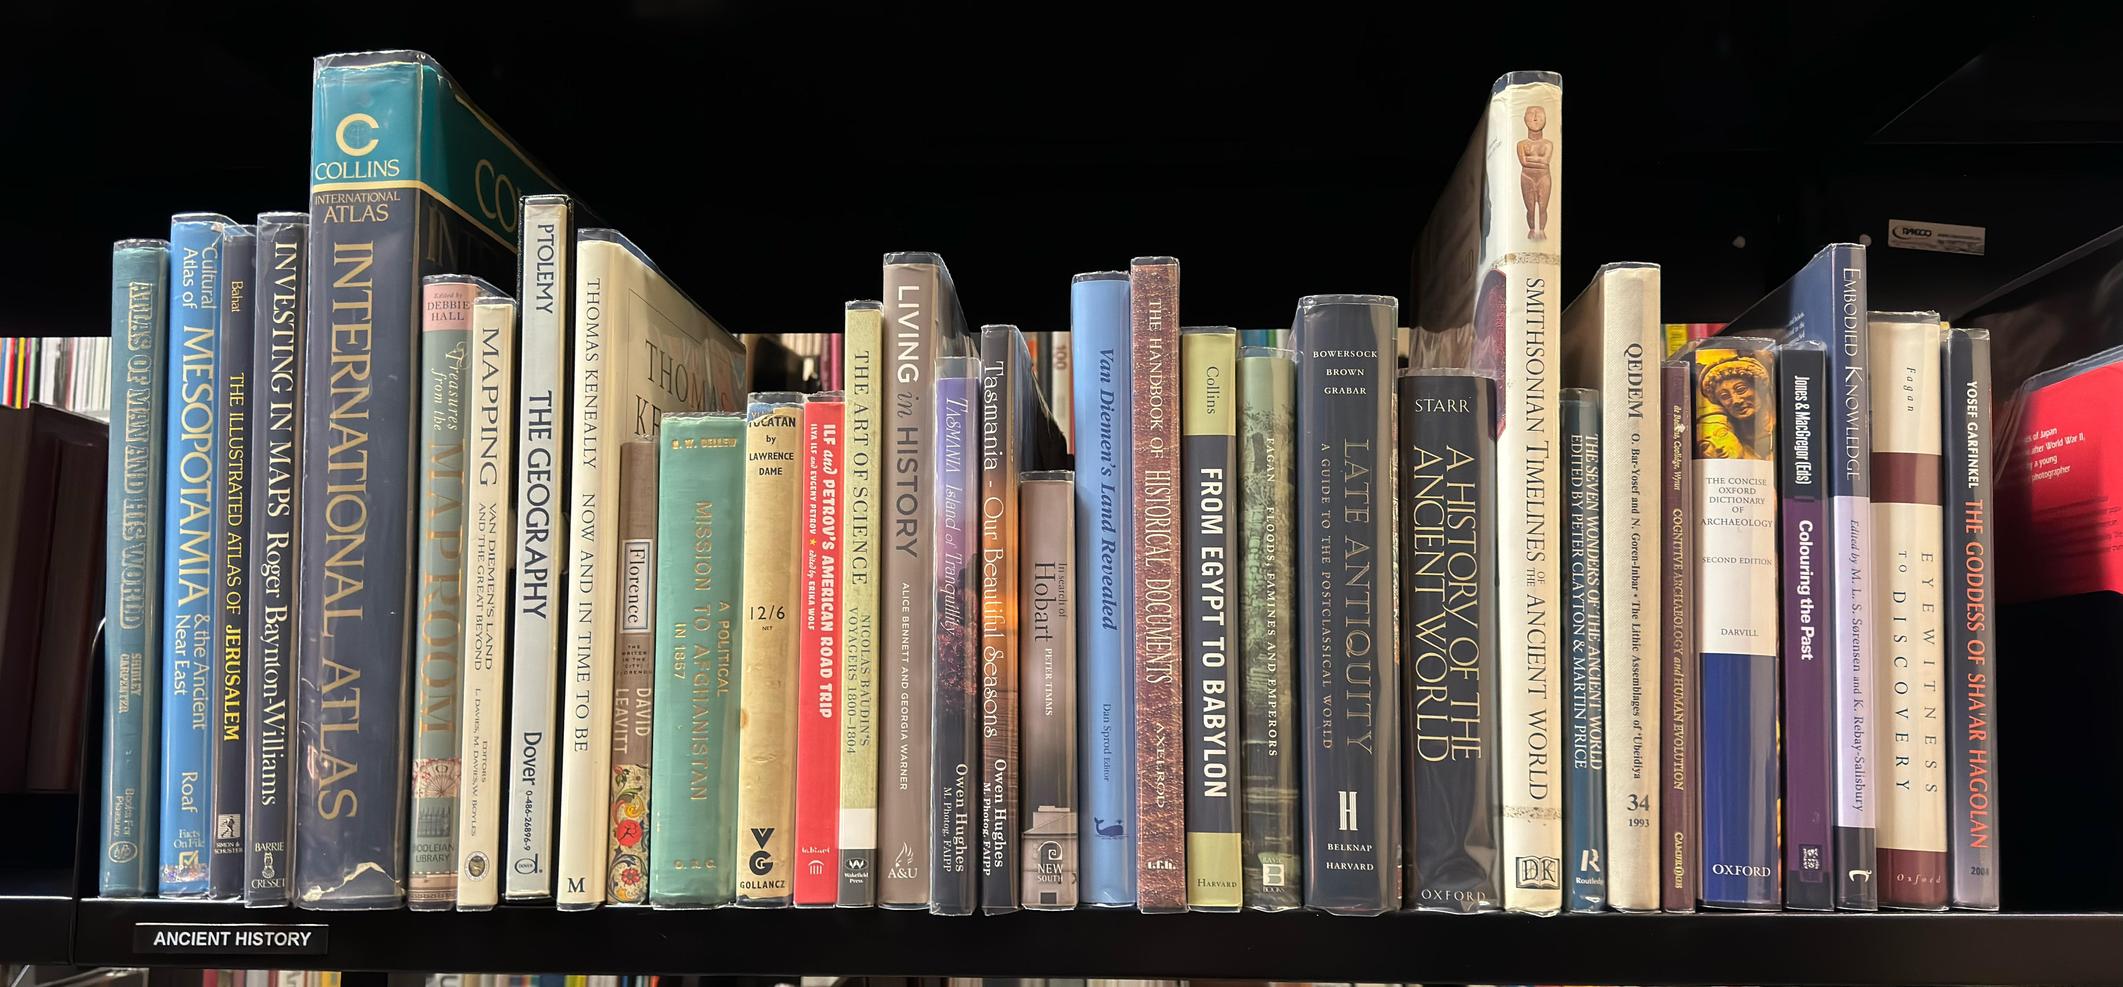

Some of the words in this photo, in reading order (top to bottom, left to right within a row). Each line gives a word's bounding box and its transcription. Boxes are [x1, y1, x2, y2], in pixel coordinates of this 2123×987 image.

[315, 160, 400, 180] COLLINS
[315, 192, 400, 205] INTERNATIONAL
[324, 204, 389, 224] ATLAS
[536, 223, 554, 314] PTOLEMY
[127, 282, 152, 350] ATLAS
[231, 281, 243, 312] Bahat
[427, 300, 471, 310] DEBBIE
[431, 312, 464, 321] HALL
[1149, 300, 1162, 331] THE
[1843, 267, 1862, 357] EMBODIED
[585, 278, 601, 362] THOMAS
[898, 285, 920, 383] LIVING
[127, 355, 152, 382] OF
[854, 350, 869, 395] THE
[1313, 350, 1378, 358] BOWERSOCK
[229, 372, 244, 406] THE
[1148, 338, 1163, 430] HANDBOOK
[1206, 367, 1220, 414] Collins
[1324, 387, 1367, 395] GRABAR
[1624, 343, 1644, 418] QEDEM
[1903, 368, 1916, 412] Fagan
[1967, 381, 1978, 418] YOSEF
[126, 389, 151, 441] MAN
[480, 328, 499, 487] MAPPING
[528, 390, 552, 441] THE
[583, 369, 598, 469] KENEALLY
[854, 403, 869, 446] ART
[897, 392, 919, 418] in
[1415, 399, 1470, 413] STARR
[1845, 365, 1864, 481] KNOWLEDGE
[321, 240, 374, 637] INTERNATIONAL
[823, 424, 836, 446] ILF
[946, 398, 968, 473] TASMANIA
[1150, 437, 1163, 458] OF
[1585, 434, 1599, 462] THE
[1967, 422, 1979, 488] GARFINKEL
[2040, 427, 2058, 440] Japan
[125, 446, 150, 493] AND
[178, 325, 214, 606] MESOPOTAMIA
[228, 412, 244, 525] ILLUSTRATED
[750, 452, 794, 460] LAWRENCE
[760, 468, 782, 476] DAME
[823, 450, 837, 474] and
[854, 452, 869, 481] OF
[1266, 438, 1275, 483] FAGAN
[1446, 445, 1475, 471] A
[428, 439, 464, 561] MAP
[896, 427, 918, 557] HISTORY
[1201, 468, 1223, 535] FROM
[1343, 439, 1370, 523] LATE
[1586, 466, 1600, 510] SEVEN
[1709, 496, 1765, 504] DICTIONARY
[1726, 478, 1768, 486] CONCISE
[122, 497, 146, 540] HIS
[478, 503, 486, 531] AND
[582, 493, 596, 542] NOW
[822, 479, 835, 550] PETROV'S
[945, 484, 963, 530] Island
[1145, 470, 1172, 567] HISTORICAL
[1413, 445, 1445, 603] ANCIENT
[1965, 500, 1984, 534] THE
[523, 448, 551, 619] GEOGRAPHY
[694, 501, 713, 591] MISSION
[851, 487, 869, 585] SCIENCE
[945, 534, 956, 548] of
[1265, 507, 1275, 567] FLOODS,
[1443, 482, 1478, 629] HISTORY
[1586, 516, 1600, 585] WONDERS
[1851, 520, 1860, 551] Edited
[227, 532, 242, 586] ATLAS
[580, 550, 594, 593] AND
[1797, 520, 1814, 594] Colouring
[1849, 552, 1860, 564] by
[1851, 568, 1861, 585] M.
[1898, 551, 1908, 573] TO
[120, 544, 146, 629] WORLD
[226, 592, 241, 615] OF
[476, 565, 485, 609] GREAT
[628, 548, 646, 624] Florence
[821, 555, 834, 632] AMERICAN
[940, 553, 962, 636] Tranquillity
[1034, 562, 1056, 642] Hobart
[1201, 546, 1224, 626] EGYPT
[1266, 572, 1276, 636] FAMINES
[1587, 589, 1600, 609] OF
[1852, 588, 1861, 600] L.
[1966, 541, 1985, 632] GODDESS
[579, 601, 593, 624] IN
[674, 623, 686, 638] IN
[694, 604, 711, 632] TO
[750, 606, 785, 620] 12/6
[1588, 612, 1601, 641] THE
[1799, 598, 1814, 622] the
[1852, 603, 1862, 615] S.
[419, 568, 462, 737] ROOM
[474, 615, 484, 671] BEYOND
[1146, 579, 1173, 684] DOCUMENTS
[1202, 637, 1225, 667] TO
[1344, 536, 1372, 755] ANTIQUITY
[1800, 626, 1814, 660] Past
[1852, 618, 1863, 674] Sørensen
[1967, 638, 1985, 666] OF
[131, 653, 141, 696] SHIRLEY
[577, 631, 592, 681] TIME
[820, 637, 833, 678] ROAD
[1267, 642, 1277, 672] AND
[1448, 637, 1480, 681] OF
[1921, 552, 1937, 792] EYEWITNESS
[224, 625, 241, 741] JERUSALEM
[1415, 611, 1448, 762] WORLD
[1588, 647, 1601, 710] ANCIENT
[1853, 677, 1862, 695] and
[1892, 591, 1910, 790] DISCOVERY
[575, 690, 590, 719] TO
[690, 644, 711, 800] AFGHANISTAN
[819, 684, 832, 718] TRIP
[1267, 679, 1277, 757] EMPERORS
[1853, 699, 1863, 712] K.
[1967, 673, 1988, 742] SHA'AR
[317, 656, 361, 821] ATLAS
[575, 728, 588, 752] BE
[1202, 679, 1227, 797] BABYLON
[1450, 692, 1481, 762] THE
[1589, 716, 1603, 770] WORLD
[956, 764, 968, 807] Owen
[994, 759, 1007, 802] Owen
[1852, 716, 1866, 812] Rebay-Salisbury
[1627, 794, 1650, 811] 34
[1969, 750, 1990, 848] HAGOLAN
[954, 813, 968, 872] Hughes
[992, 809, 1007, 867] Hughes
[1629, 819, 1650, 827] 1993
[1037, 864, 1063, 873] NEW
[1327, 843, 1373, 851] BELKNAP
[1712, 864, 1771, 877] OXFORD
[1421, 889, 1486, 900] OXFORD
[153, 931, 231, 947] ANCIENT
[235, 930, 312, 946] HISTORY
